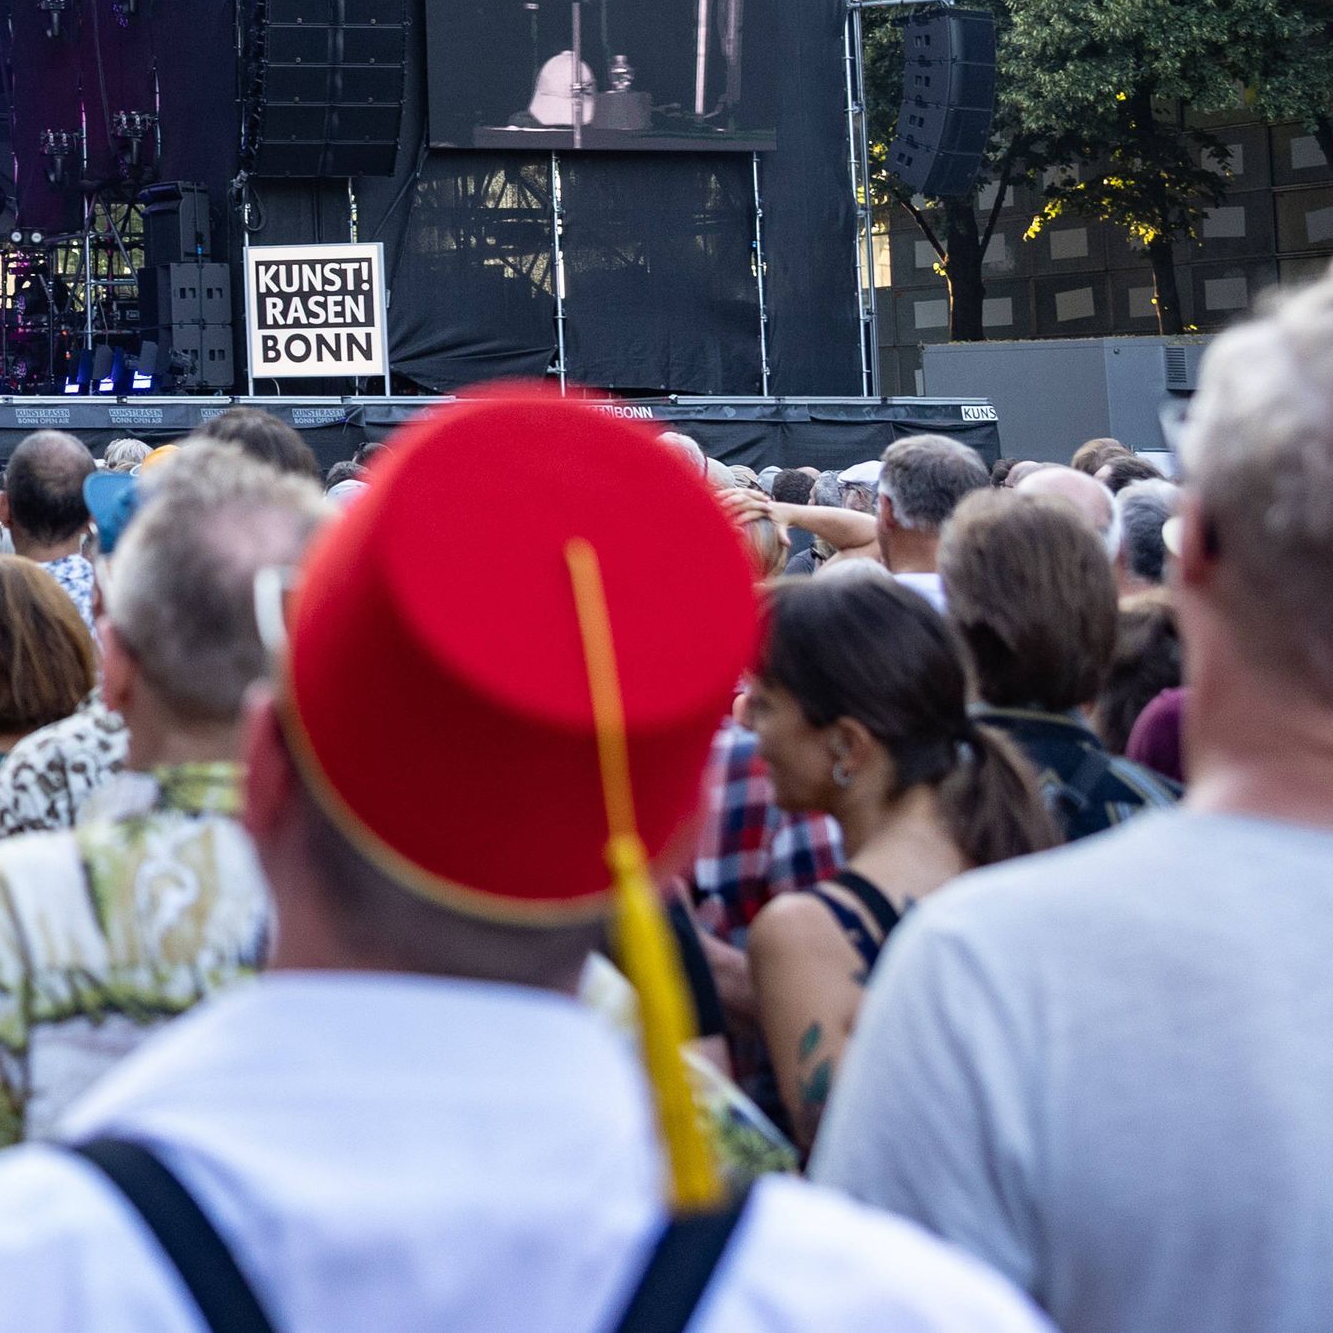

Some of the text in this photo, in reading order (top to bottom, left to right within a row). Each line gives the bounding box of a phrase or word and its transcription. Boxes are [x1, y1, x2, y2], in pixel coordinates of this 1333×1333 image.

[258, 262, 370, 294] KUNST!
[265, 294, 366, 325] RASEN
[262, 332, 373, 363] BONN
[614, 406, 654, 419] BONN
